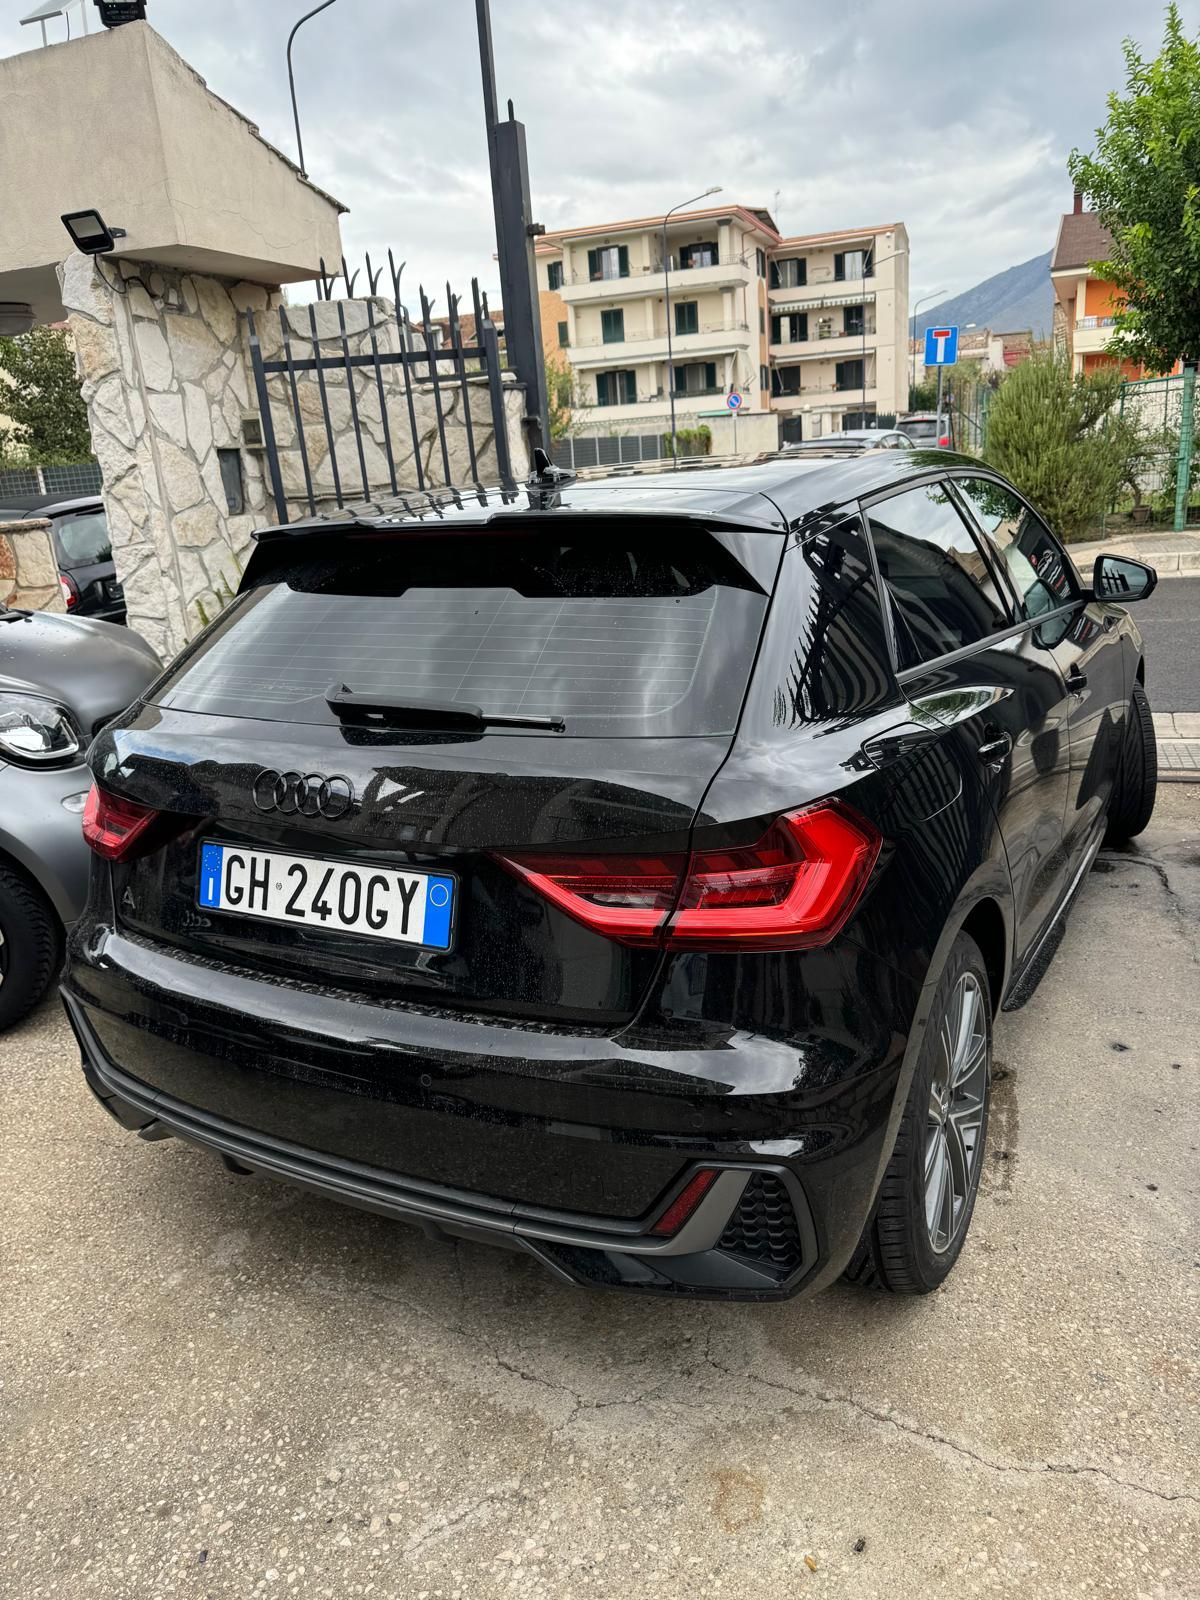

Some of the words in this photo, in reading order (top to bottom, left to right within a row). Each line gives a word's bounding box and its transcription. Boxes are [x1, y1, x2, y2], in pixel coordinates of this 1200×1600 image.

[207, 877, 214, 901] I
[225, 854, 271, 911] GH
[284, 863, 420, 935] 240GY
